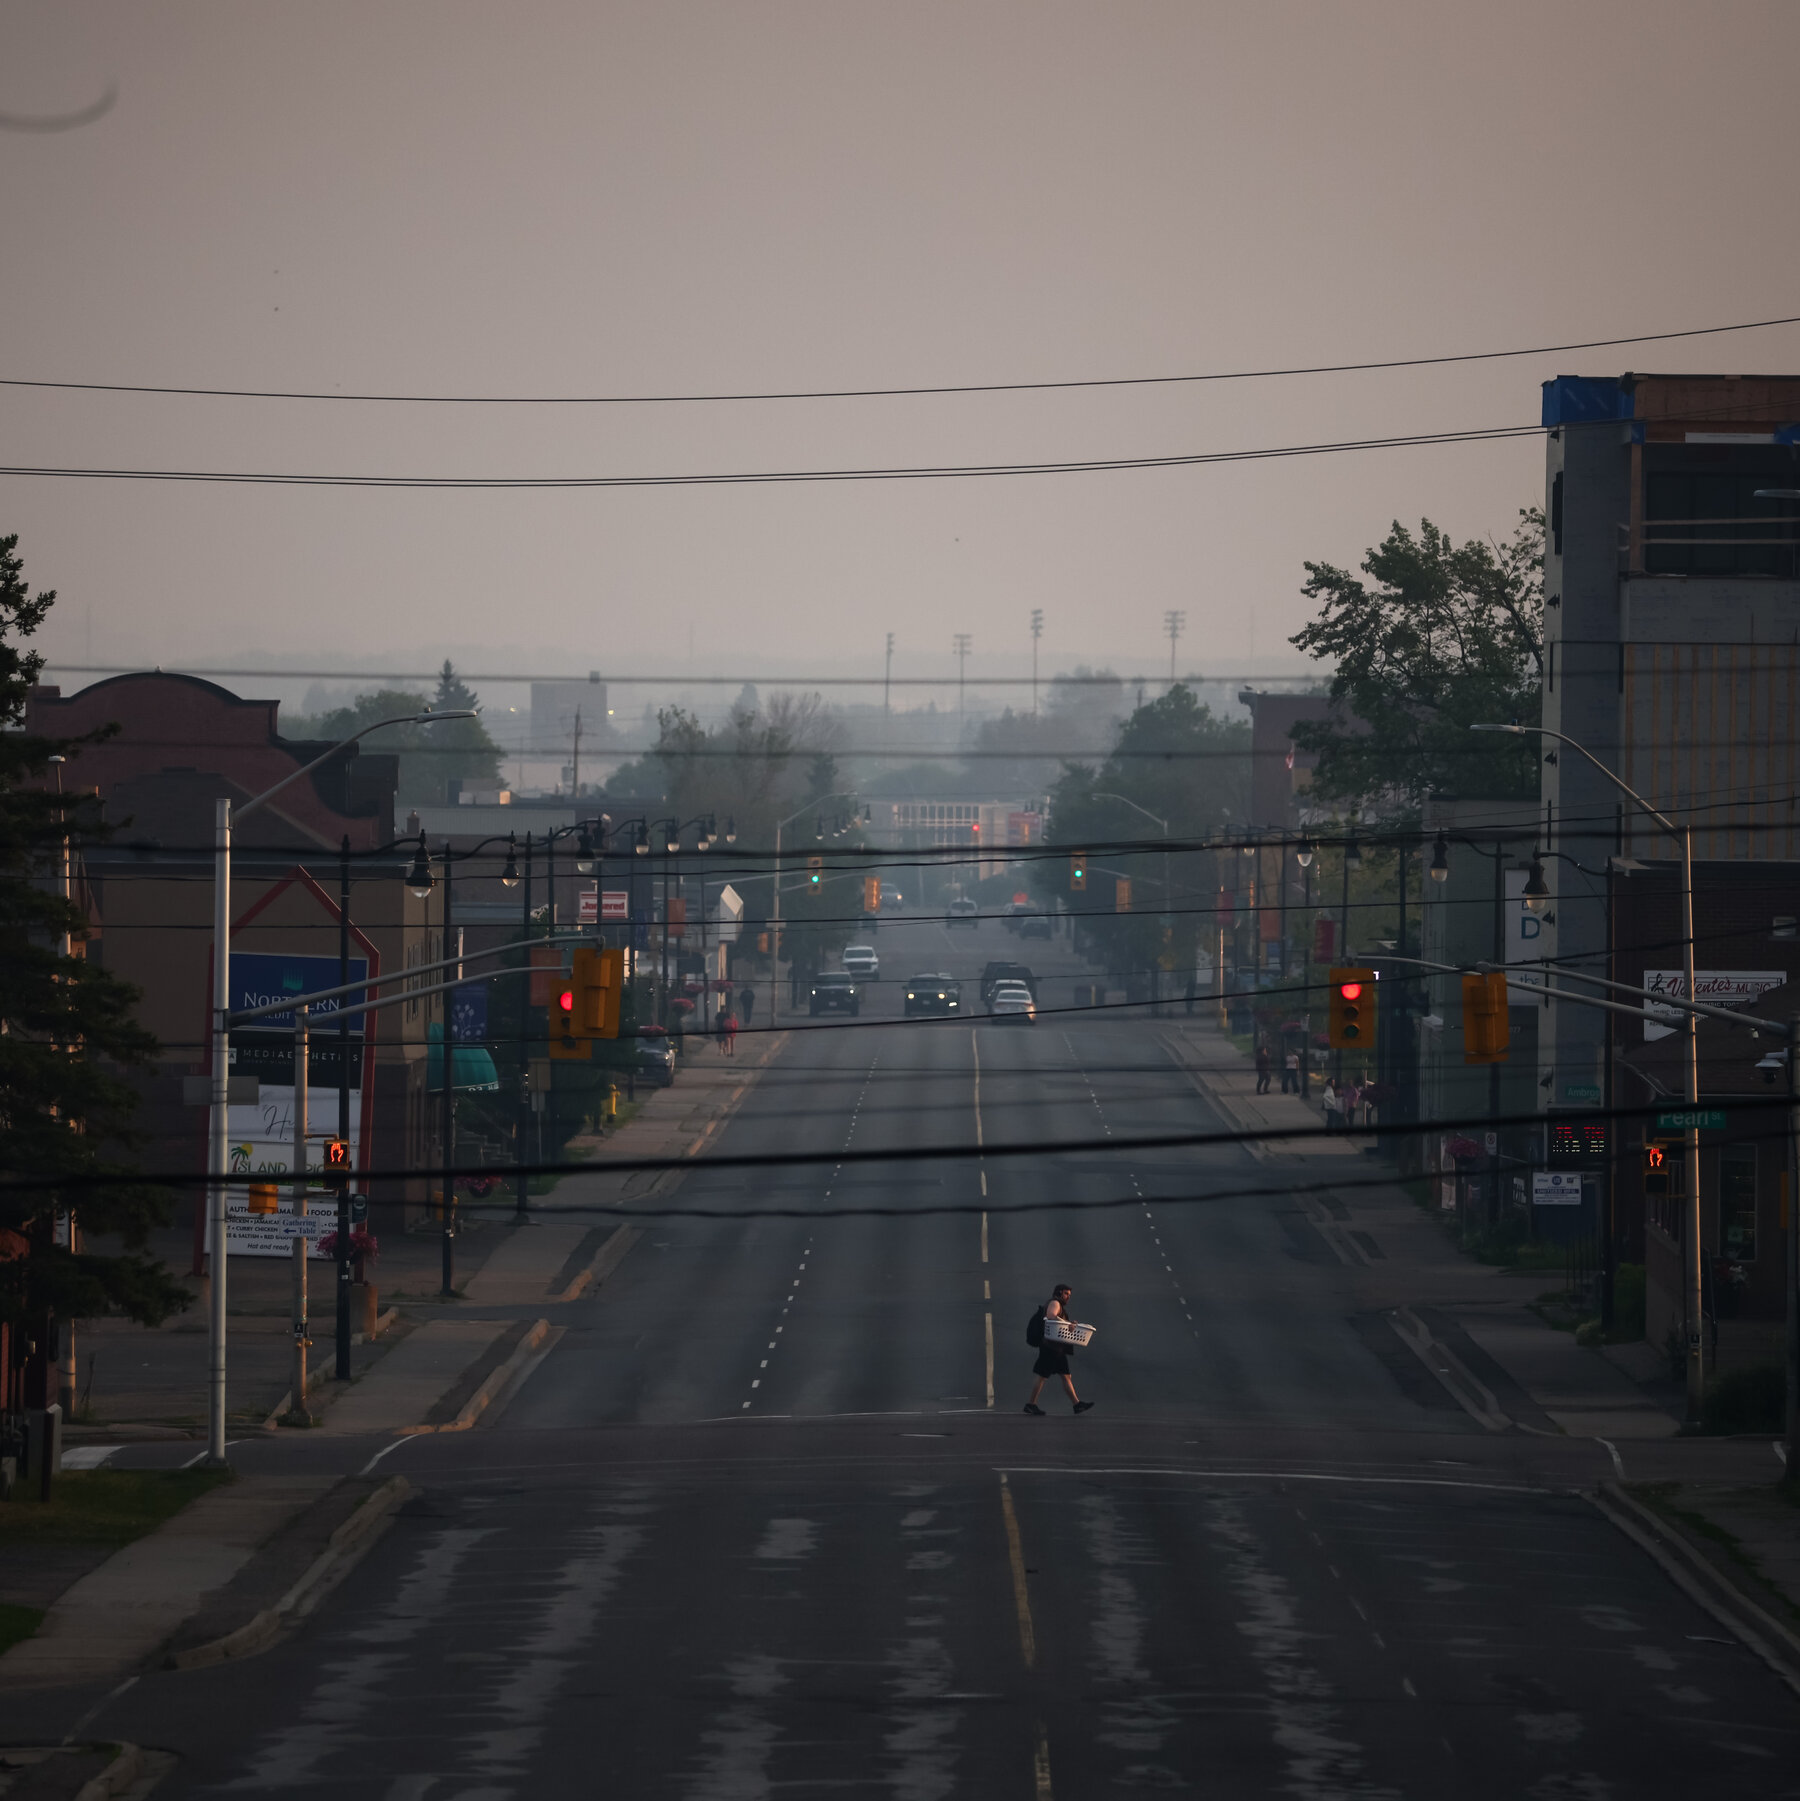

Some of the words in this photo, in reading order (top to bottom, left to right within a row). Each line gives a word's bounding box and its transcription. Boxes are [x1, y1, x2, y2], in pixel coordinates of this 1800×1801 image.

[582, 902, 625, 910] Jonered
[243, 1049, 358, 1062] MEDIAEHETIS
[1660, 1110, 1708, 1126] Pearl
[311, 1209, 332, 1217] FOOD
[282, 1219, 317, 1228] Gathering
